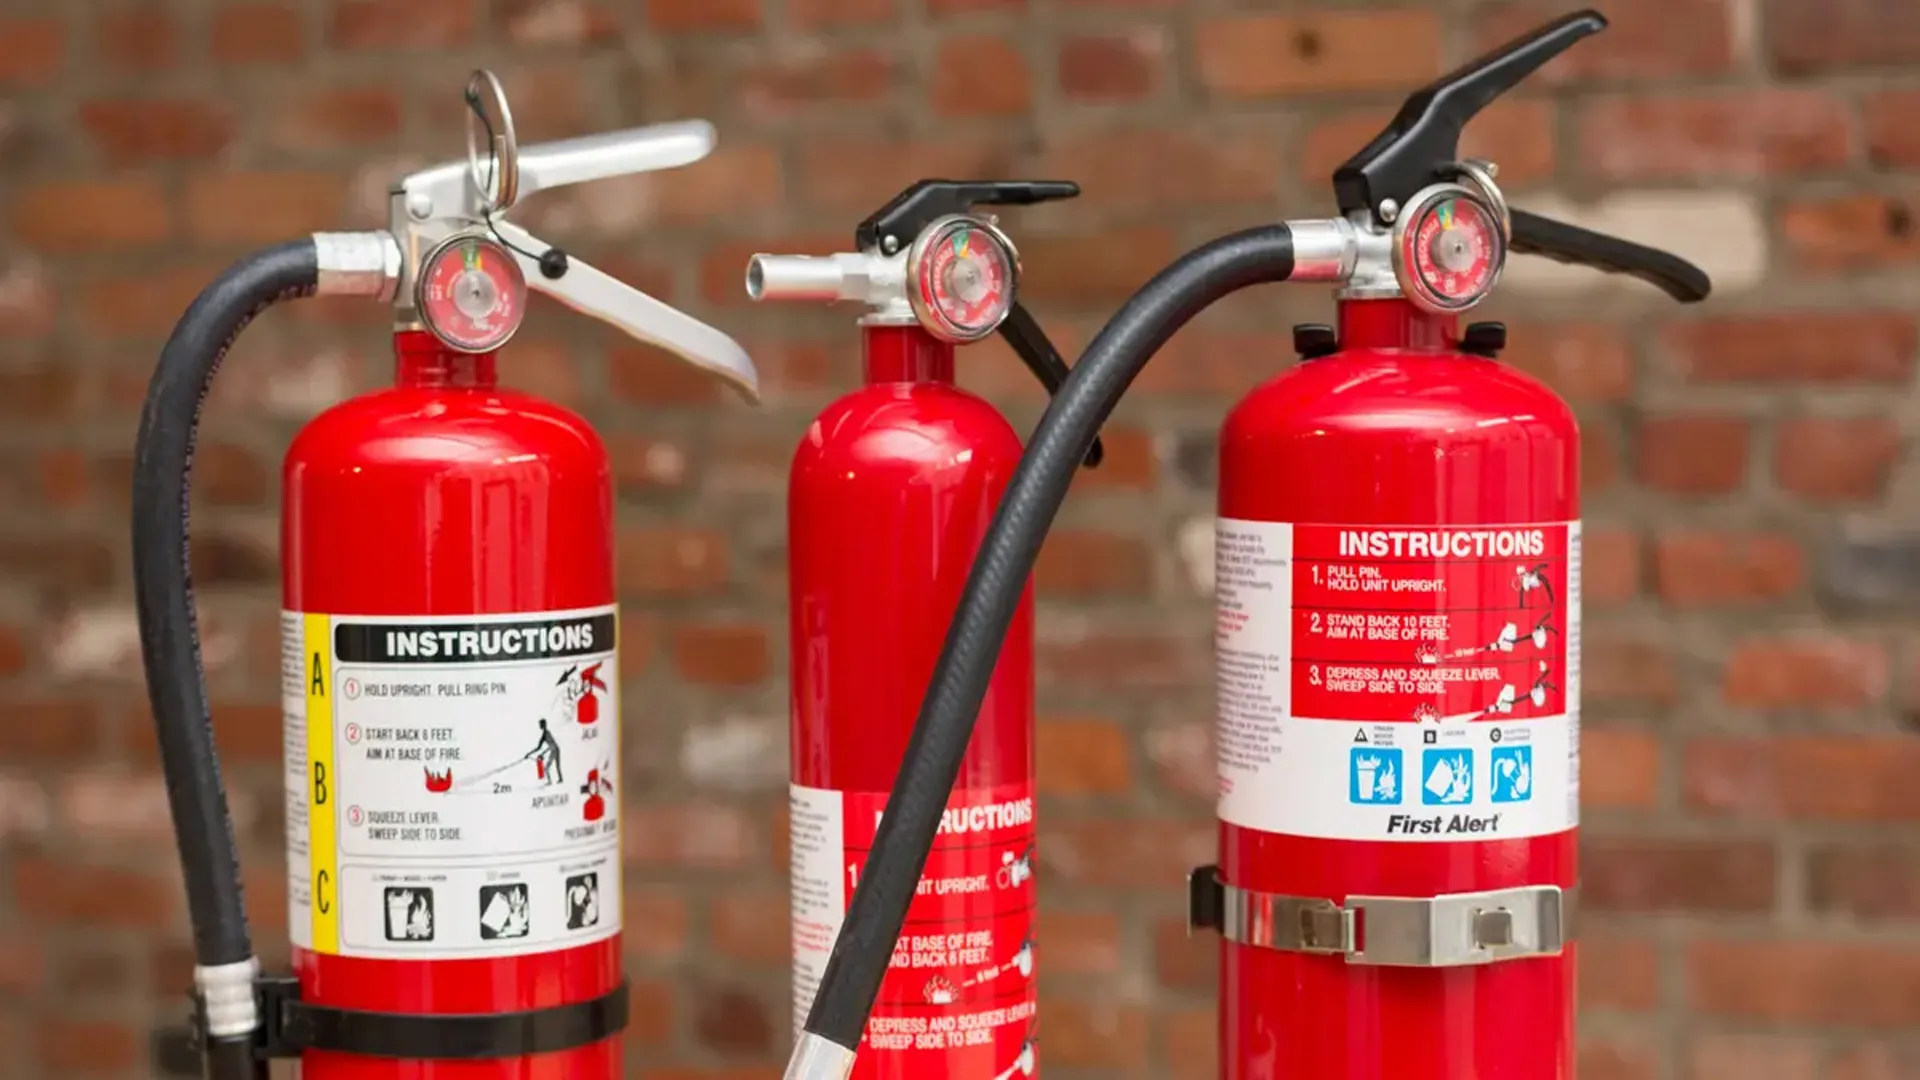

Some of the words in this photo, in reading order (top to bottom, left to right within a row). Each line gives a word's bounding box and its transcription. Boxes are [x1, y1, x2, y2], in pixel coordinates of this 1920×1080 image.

[1339, 530, 1544, 557] INSTRUCTIONS
[1312, 565, 1323, 584] 1.
[1327, 566, 1356, 578] PULL
[1359, 567, 1381, 578] PIN.
[1327, 579, 1359, 591] HOLD
[1361, 579, 1389, 591] UNIT
[1391, 580, 1446, 592] UPRIGHT.
[1310, 612, 1323, 633] 2.
[1327, 614, 1365, 627] STAND
[1368, 615, 1400, 627] BACK
[1404, 616, 1416, 627] 10
[1420, 616, 1450, 628] FEET.
[386, 624, 593, 656] INSTRUCTIONS
[1327, 627, 1347, 639] AIM
[1350, 628, 1365, 639] AT
[1368, 628, 1399, 640] BASE
[1401, 629, 1418, 640] OF
[1421, 629, 1449, 640] FIRE.
[312, 652, 324, 696] A
[1310, 665, 1322, 685] 3.
[1326, 667, 1379, 680] DEPRESS
[1382, 668, 1406, 680] AND
[1409, 668, 1463, 681] SQUEEZE
[1466, 668, 1501, 681] LEVER.
[349, 682, 355, 693] 1
[365, 684, 388, 697] HOLD
[438, 684, 461, 696] PULL
[465, 683, 489, 696] RING
[491, 682, 506, 694] PIN
[1326, 680, 1366, 692] SWEEP
[1368, 681, 1395, 693] SIDE
[1399, 681, 1414, 693] TO
[1417, 681, 1446, 693] SIDE.
[350, 727, 357, 740] 2
[366, 728, 393, 740] START
[396, 728, 419, 741] BACK
[366, 748, 382, 760] AIM
[385, 748, 395, 760] AT
[398, 748, 422, 760] BASE
[425, 748, 437, 760] OF
[314, 762, 327, 804] B
[493, 783, 512, 794] 2m
[352, 808, 360, 823] 3
[368, 811, 406, 824] SQUEEZE
[874, 798, 1032, 835] IRUCTIONS
[1387, 814, 1442, 833] First
[1446, 814, 1499, 833] Alert
[368, 828, 398, 840] SWEEP
[401, 828, 421, 840] SIDE
[425, 828, 437, 840] TO
[317, 870, 329, 914] C
[935, 875, 989, 895] UPRIGHT.
[912, 935, 945, 951] BASE
[947, 933, 965, 948] OF
[966, 930, 992, 947] FIRE.
[912, 952, 946, 968] BACK
[959, 948, 989, 965] FEET.
[870, 1017, 927, 1033] DEPRESS
[930, 1015, 955, 1032] AND
[958, 1009, 1005, 1030] SQUEEZE
[870, 1033, 913, 1049] SWEEP
[915, 1032, 944, 1049] SIDE
[948, 1032, 963, 1047] TO
[965, 1029, 992, 1046] SIDE.
